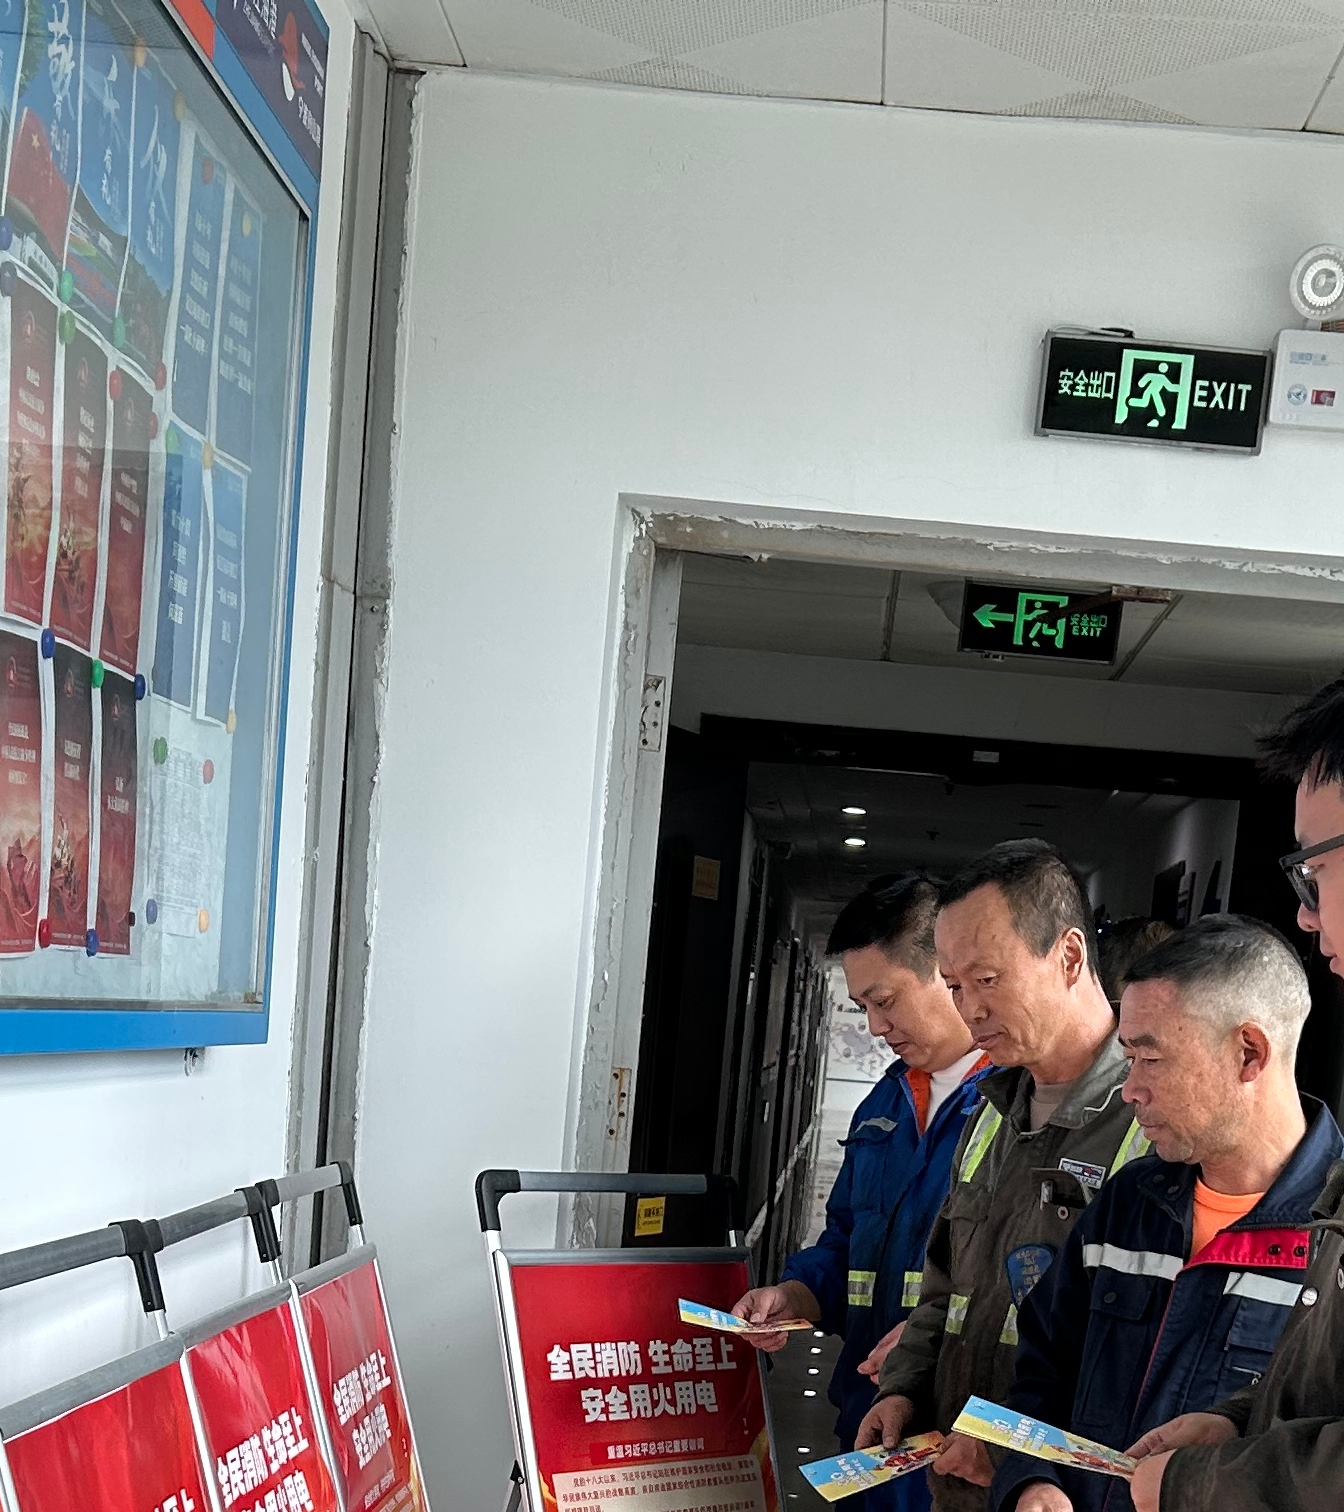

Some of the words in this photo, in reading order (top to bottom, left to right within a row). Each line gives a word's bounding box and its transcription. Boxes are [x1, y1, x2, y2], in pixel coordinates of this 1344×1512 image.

[1058, 369, 1116, 400] 安全出口
[1193, 379, 1253, 412] EXIT
[1070, 613, 1108, 629] 安全出口
[1071, 625, 1103, 637] EXIT
[544, 1339, 643, 1381] 全民消防
[646, 1334, 737, 1375] 生命至上
[579, 1377, 719, 1423] 安全用火用电
[259, 1402, 309, 1475] 生命至上
